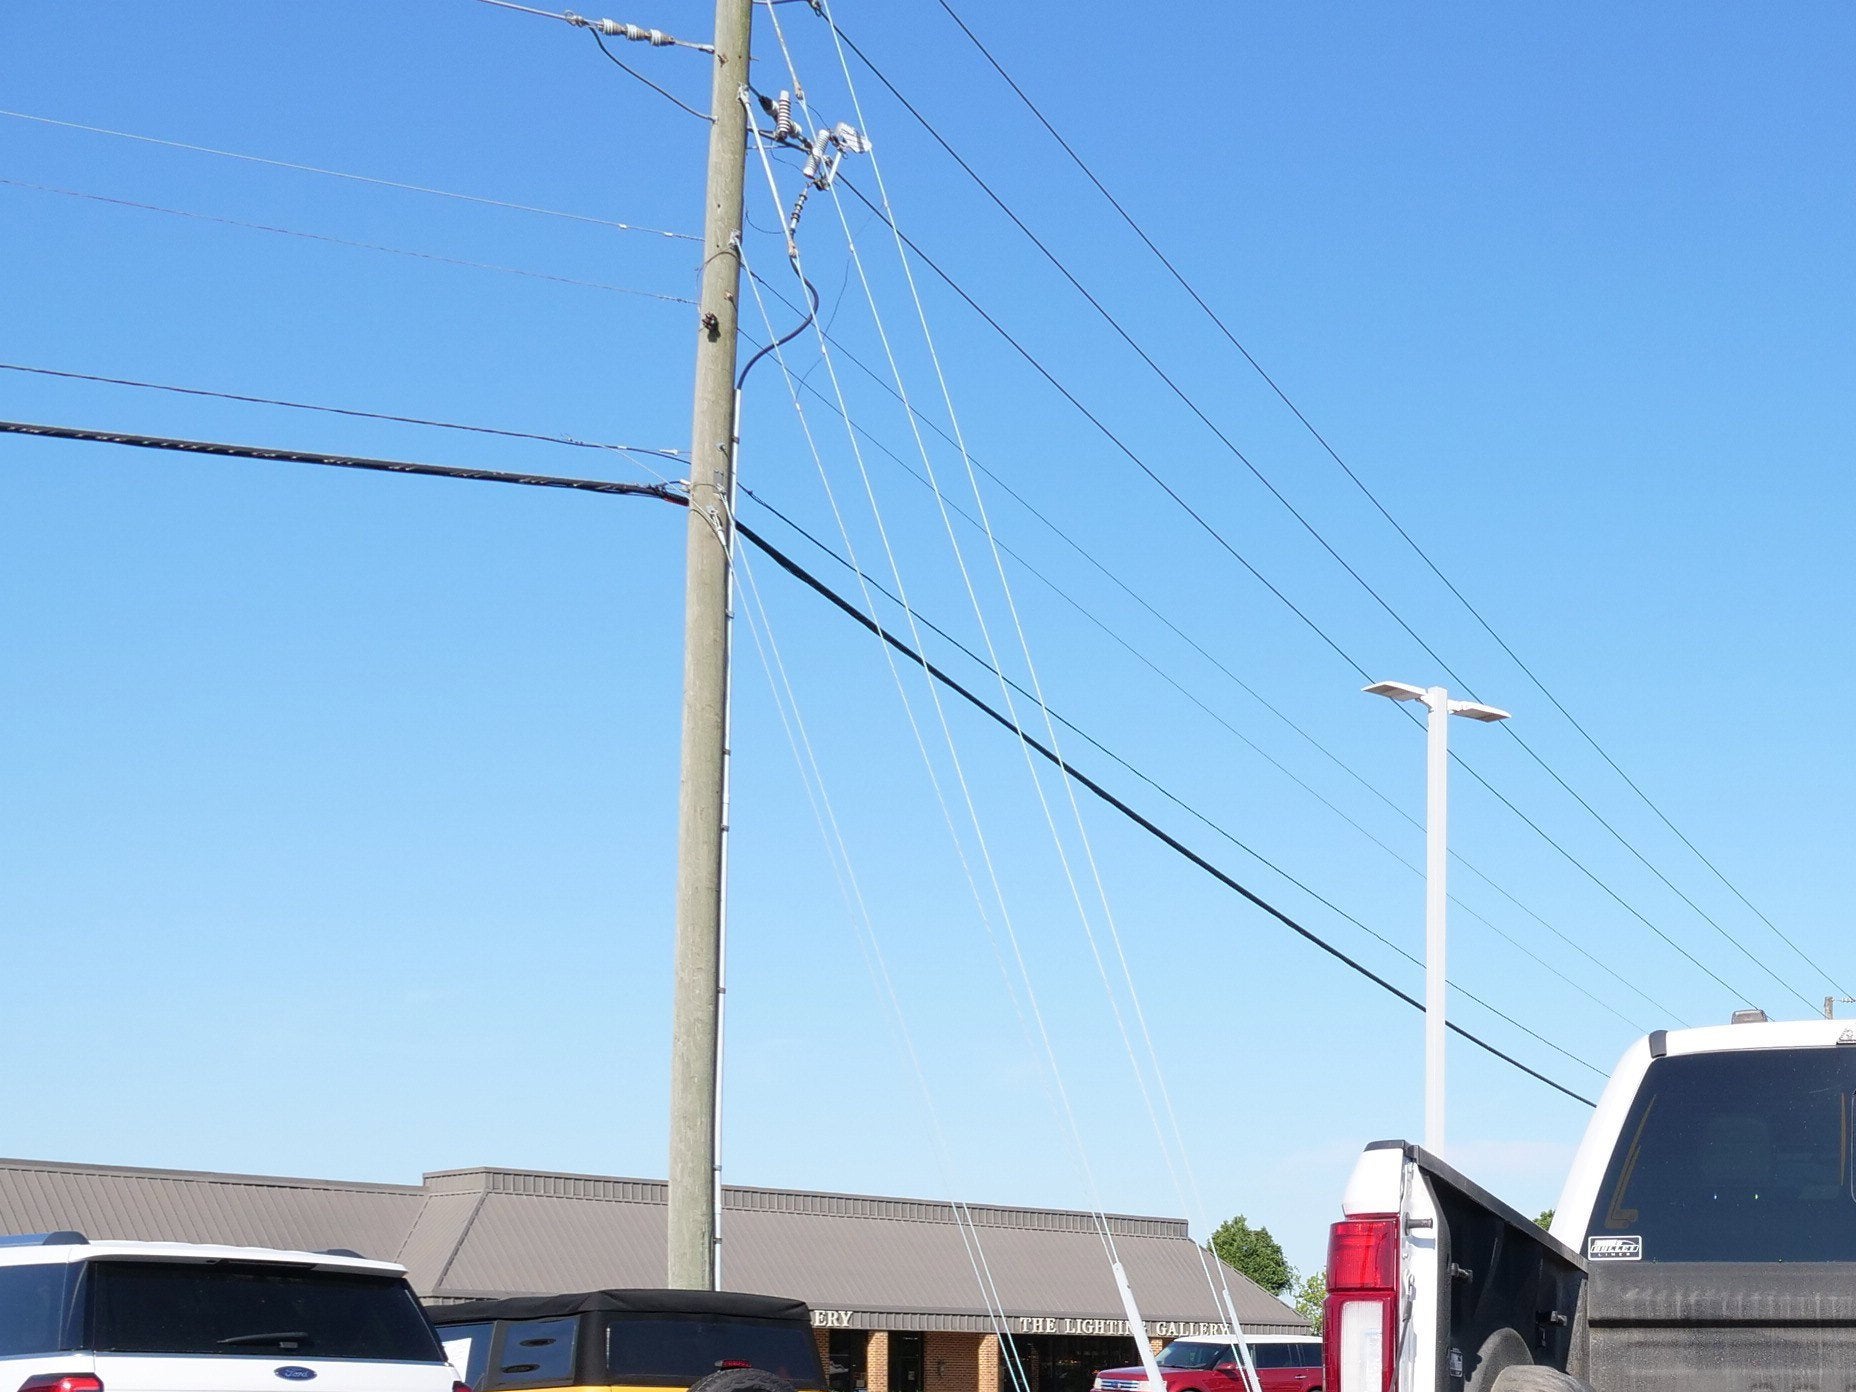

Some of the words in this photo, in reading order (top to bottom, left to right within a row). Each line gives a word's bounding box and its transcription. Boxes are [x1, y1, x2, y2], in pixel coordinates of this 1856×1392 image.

[1019, 1316, 1057, 1333] THE
[1156, 1321, 1231, 1336] GALLERY
[284, 1367, 310, 1378] Ford
